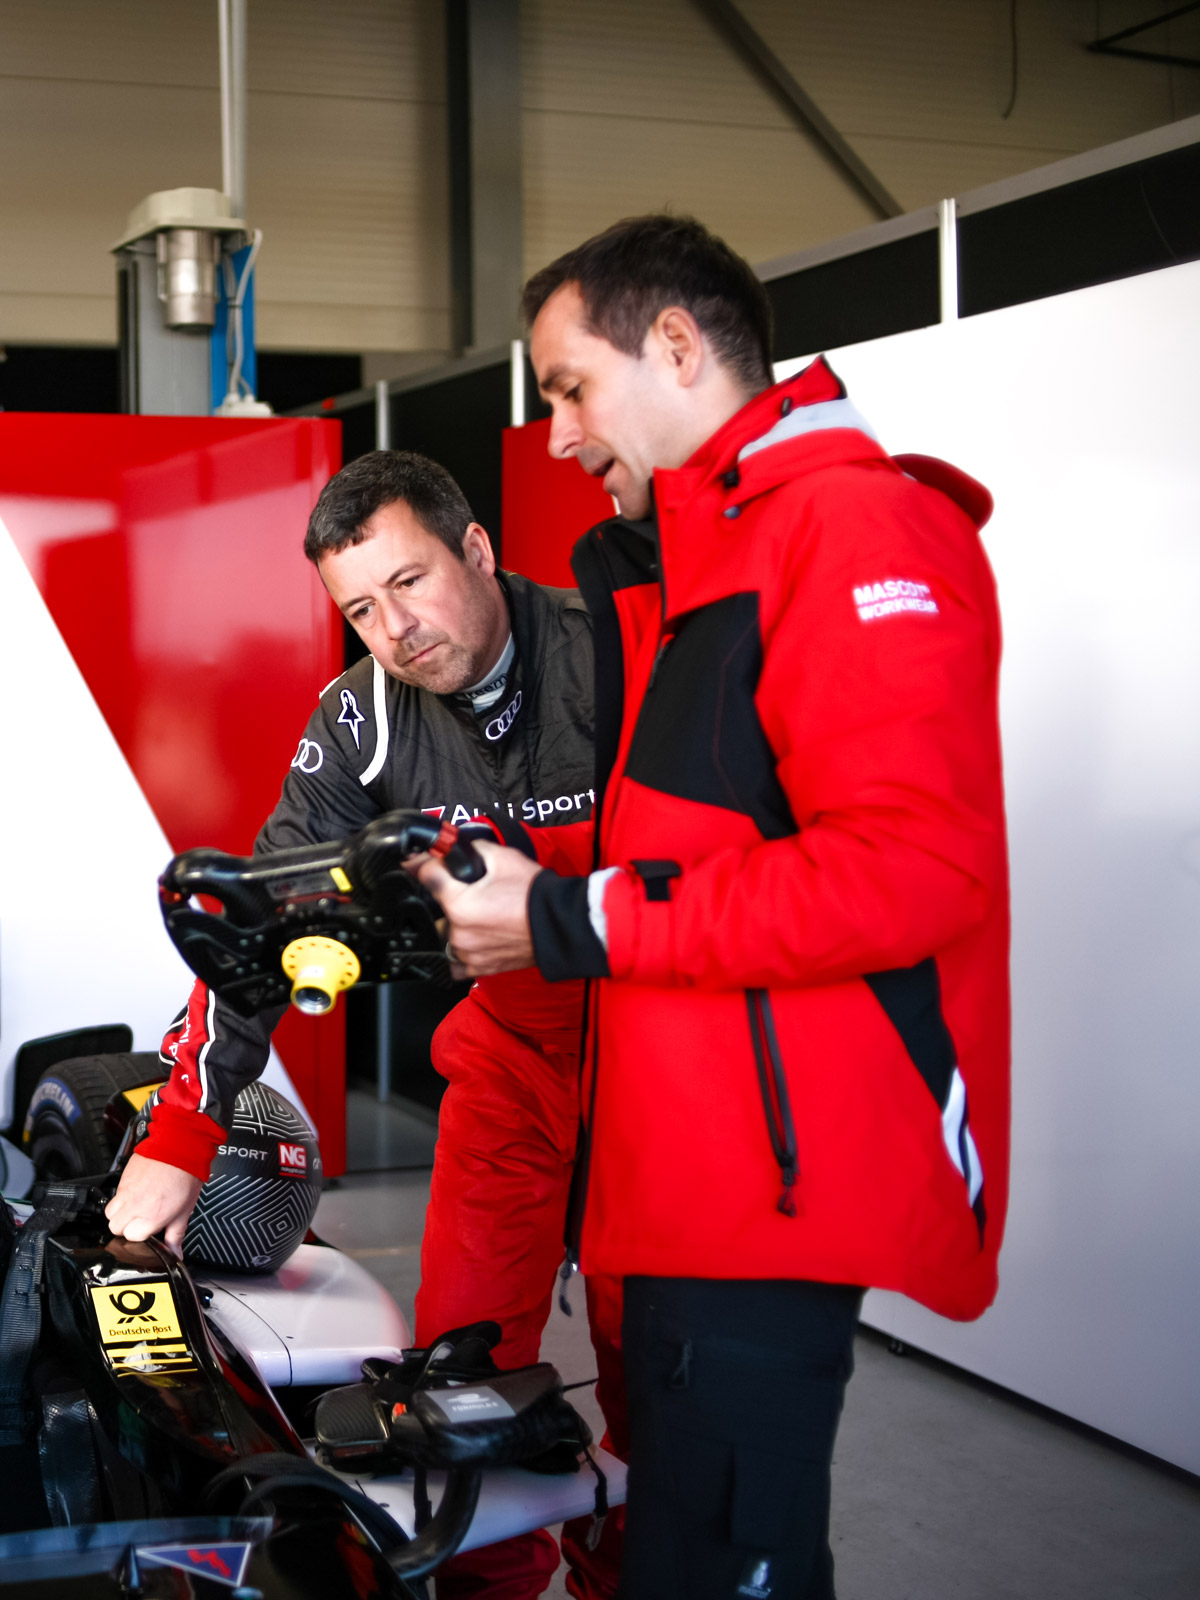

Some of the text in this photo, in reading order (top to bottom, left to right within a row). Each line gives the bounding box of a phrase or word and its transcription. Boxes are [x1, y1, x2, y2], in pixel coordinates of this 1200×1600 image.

[853, 580, 930, 605] MASCOT
[451, 789, 596, 826] Ai Sport
[218, 1144, 268, 1161] SPORT
[280, 1144, 306, 1167] NG
[109, 1325, 172, 1337] Deutsche Post
